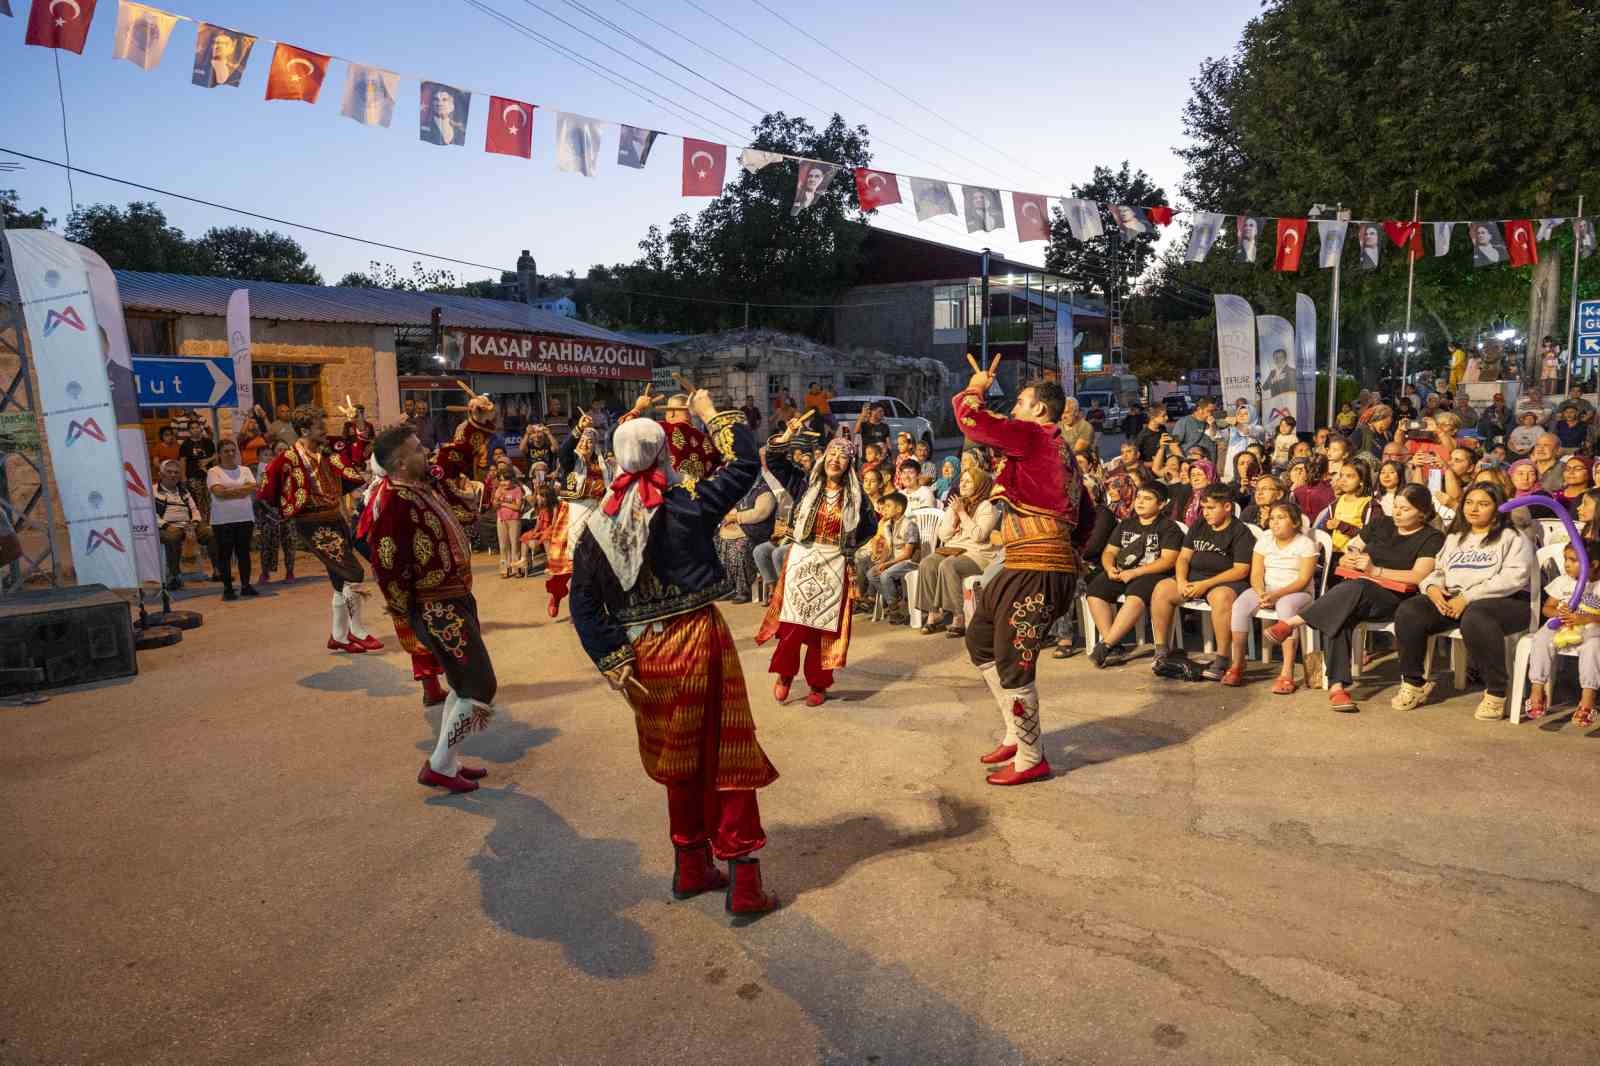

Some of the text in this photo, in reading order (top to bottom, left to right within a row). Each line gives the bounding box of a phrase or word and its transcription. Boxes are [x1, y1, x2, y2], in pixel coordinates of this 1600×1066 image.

[470, 335, 532, 358] KASAP
[504, 360, 513, 370] ET
[516, 361, 552, 372] MANGAL
